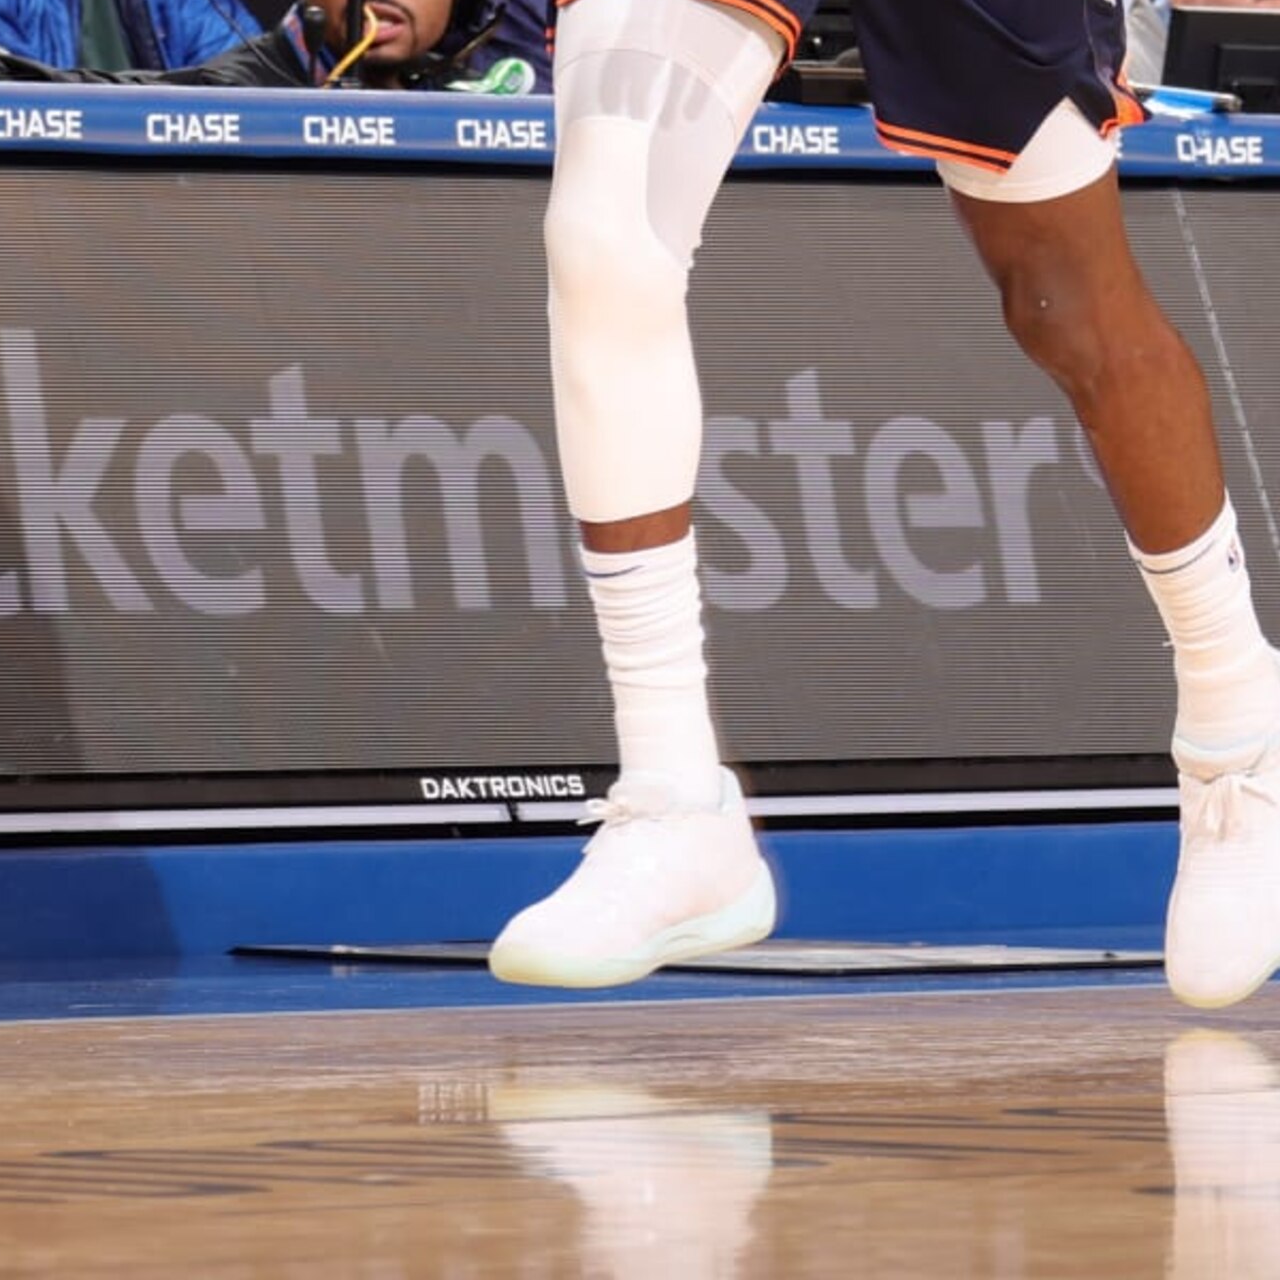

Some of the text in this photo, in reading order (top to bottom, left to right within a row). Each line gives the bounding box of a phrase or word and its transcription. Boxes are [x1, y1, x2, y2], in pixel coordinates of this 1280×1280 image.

[145, 112, 242, 144] CHASE
[302, 115, 397, 147] CHASE
[456, 118, 548, 151] CHASE
[752, 124, 840, 155] CHASE
[1175, 133, 1264, 166] CHASE
[420, 775, 586, 800] DAKTRONICS
